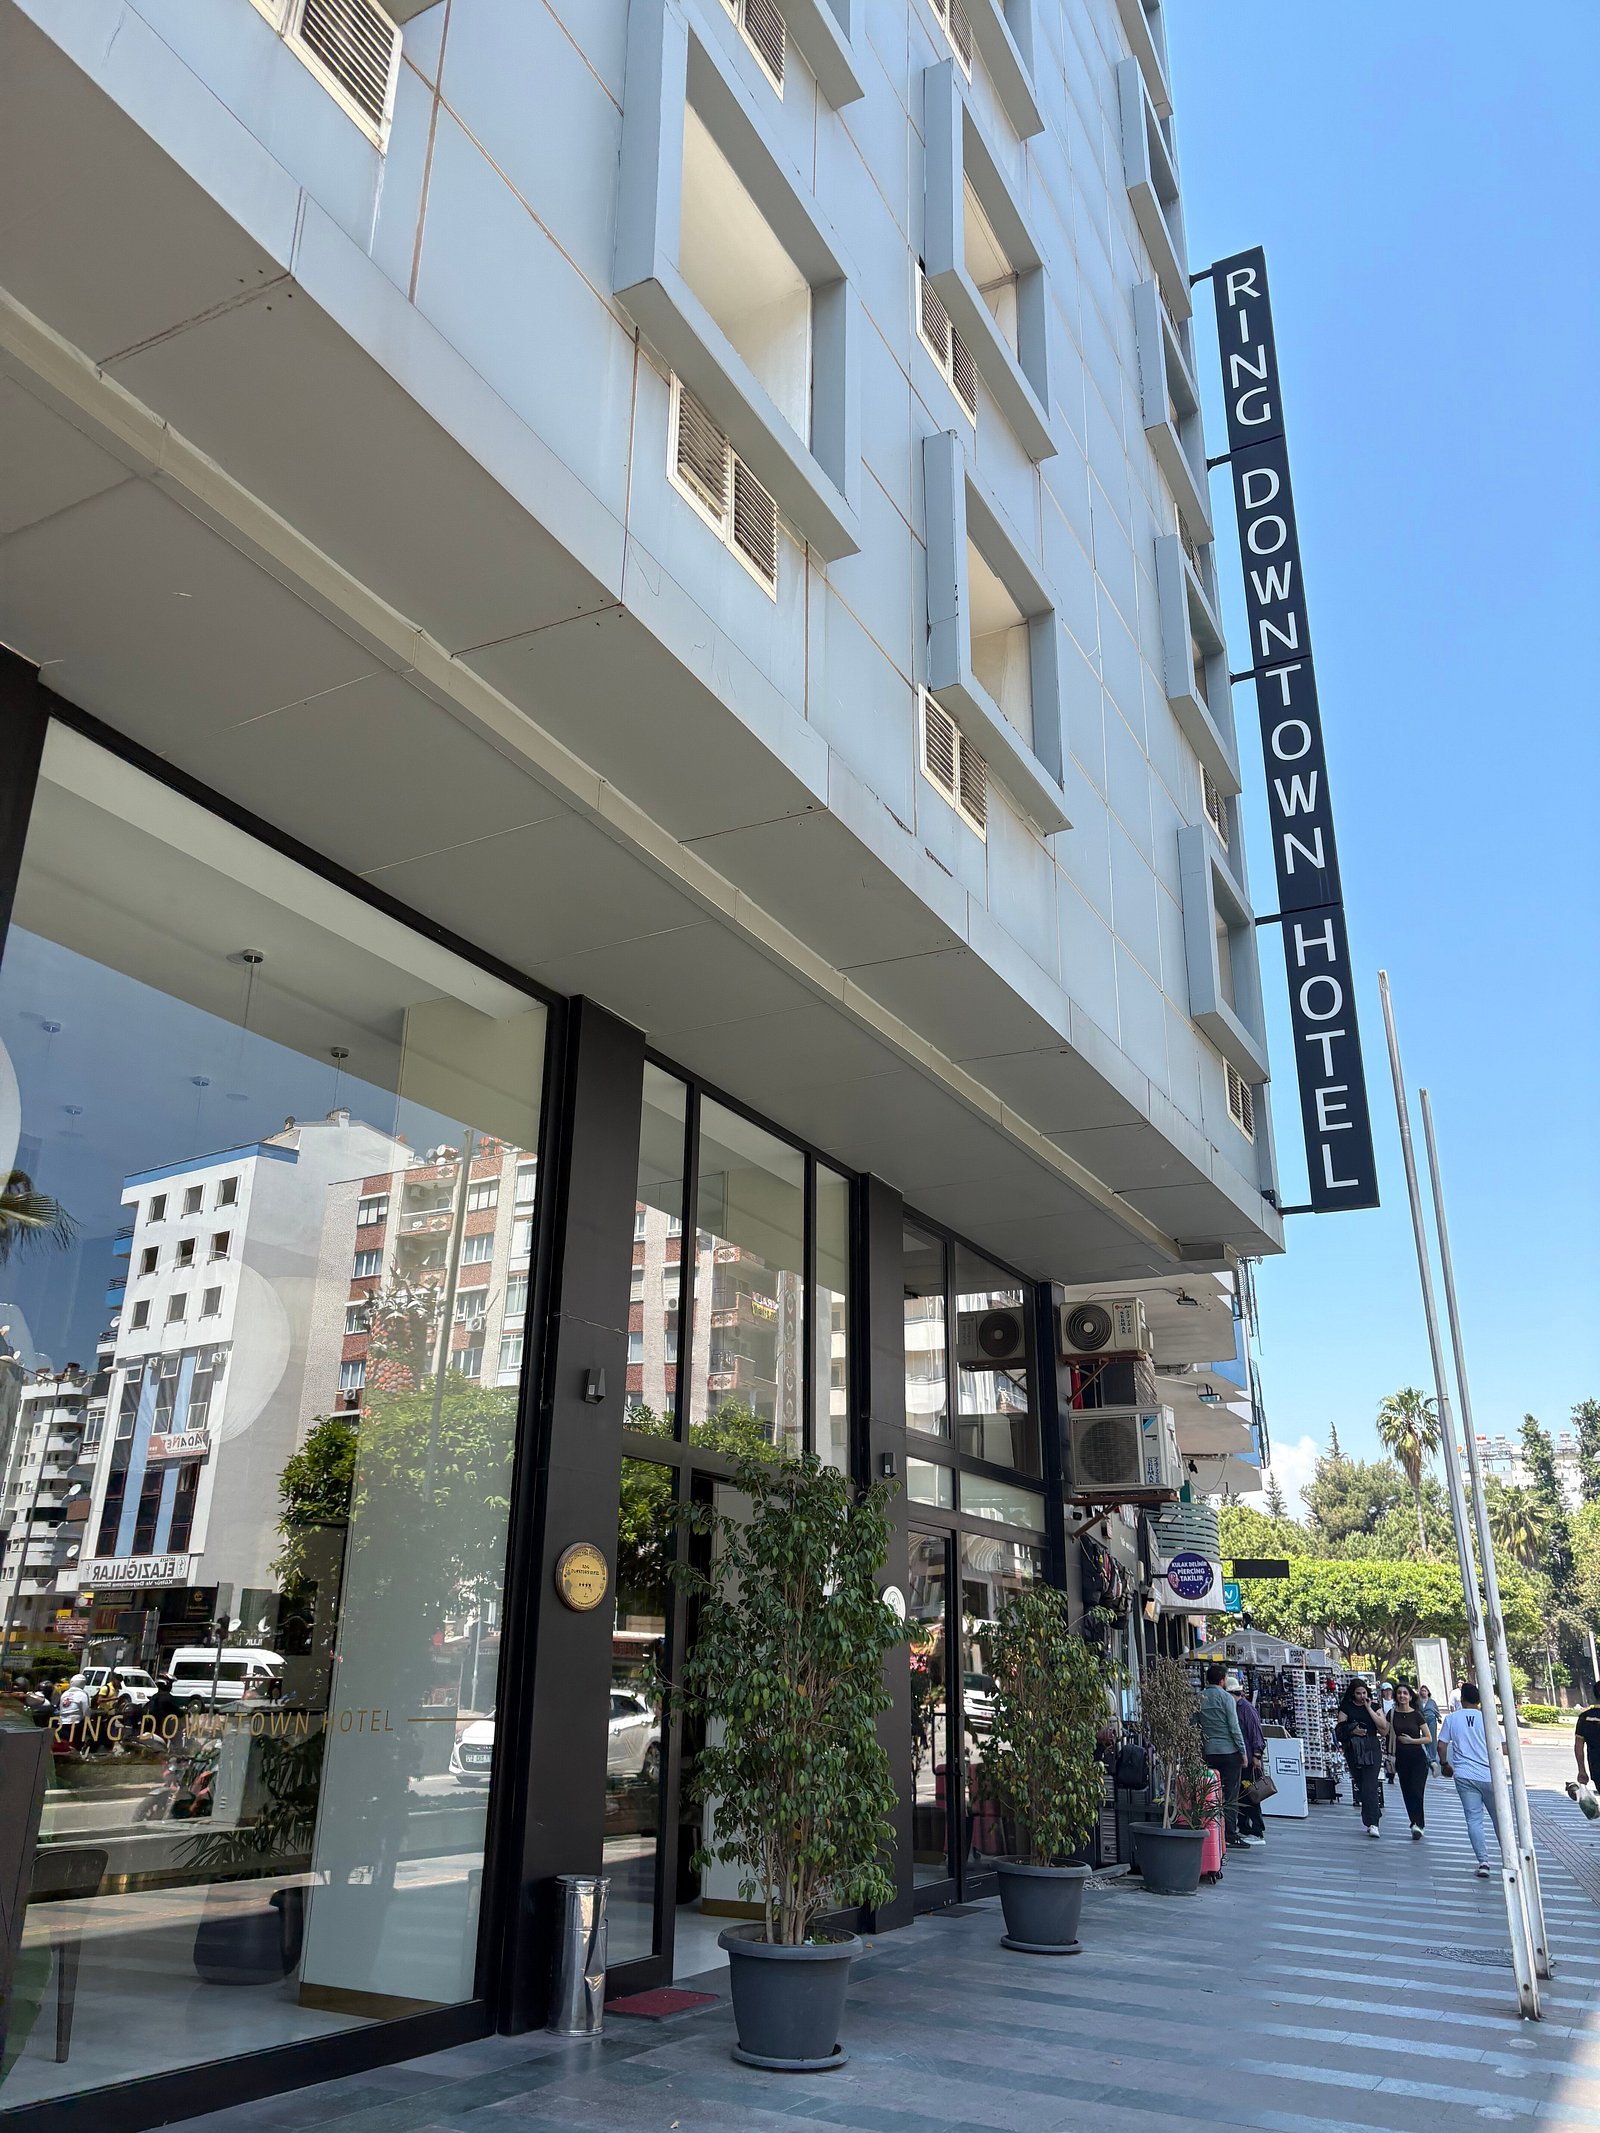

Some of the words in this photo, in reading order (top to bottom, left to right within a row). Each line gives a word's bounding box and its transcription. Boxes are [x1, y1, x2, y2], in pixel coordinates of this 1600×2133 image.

[1226, 267, 1272, 427] RING
[1242, 468, 1326, 875] DOWNTOWN
[1294, 917, 1359, 1190] HOTEL
[47, 1714, 124, 1743] RING
[139, 1711, 310, 1741] DOWNTOWN
[321, 1709, 394, 1734] HOTEL
[1465, 1715, 1475, 1728] W
